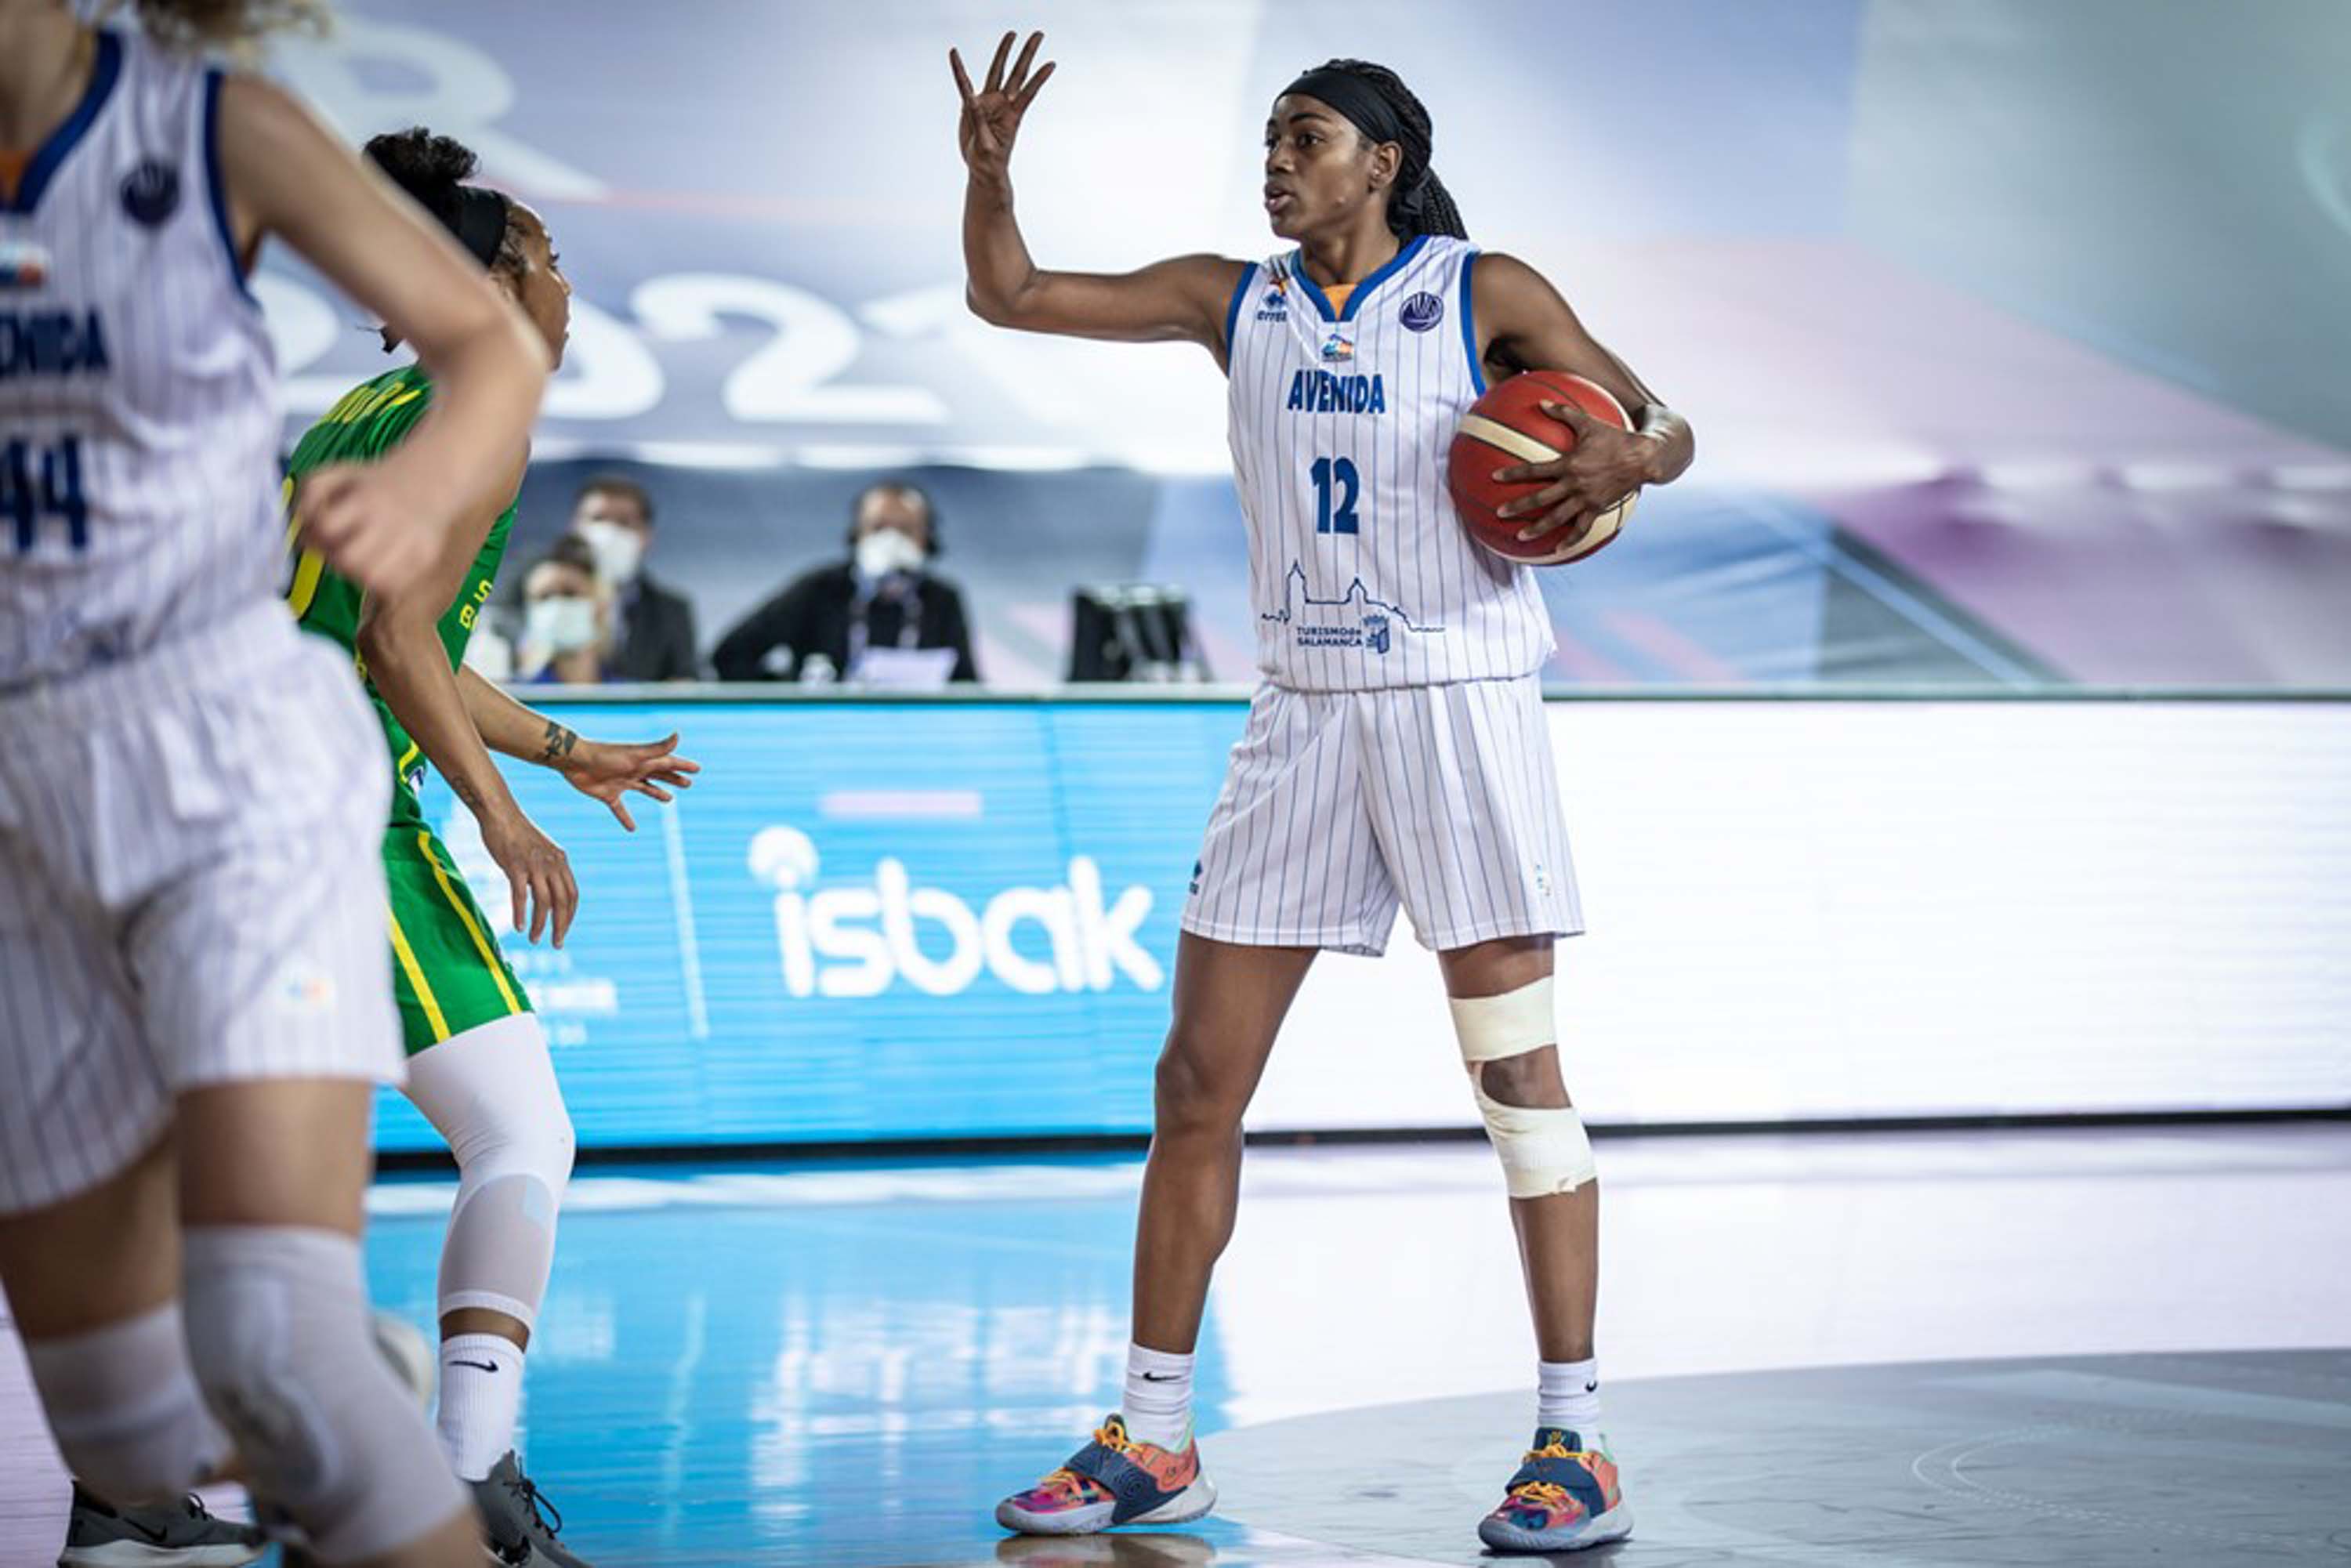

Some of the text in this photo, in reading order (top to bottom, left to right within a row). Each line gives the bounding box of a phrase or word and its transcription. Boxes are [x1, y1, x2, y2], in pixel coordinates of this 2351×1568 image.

[1287, 369, 1386, 415] AVENIDA
[1310, 456, 1360, 535] 12
[1297, 636, 1363, 647] SALAMANCA
[747, 824, 1166, 998] isbak
